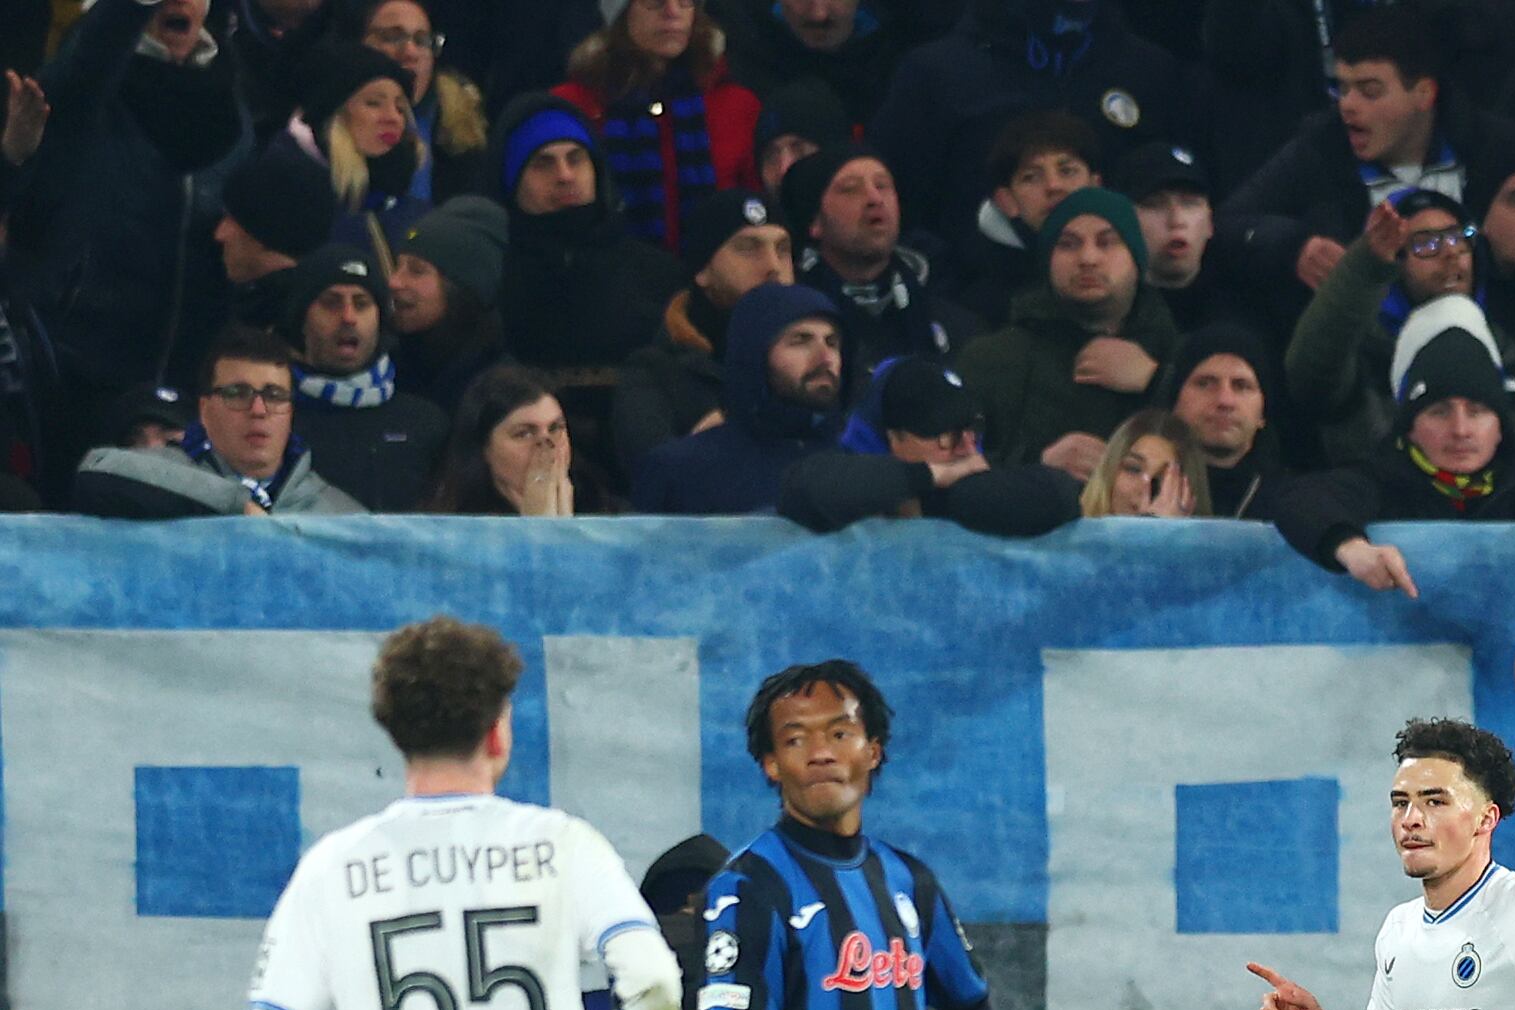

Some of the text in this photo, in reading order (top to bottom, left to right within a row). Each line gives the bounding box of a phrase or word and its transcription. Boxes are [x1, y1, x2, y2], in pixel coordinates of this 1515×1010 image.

[345, 840, 559, 899] DE CUYPER
[822, 931, 925, 993] Lete
